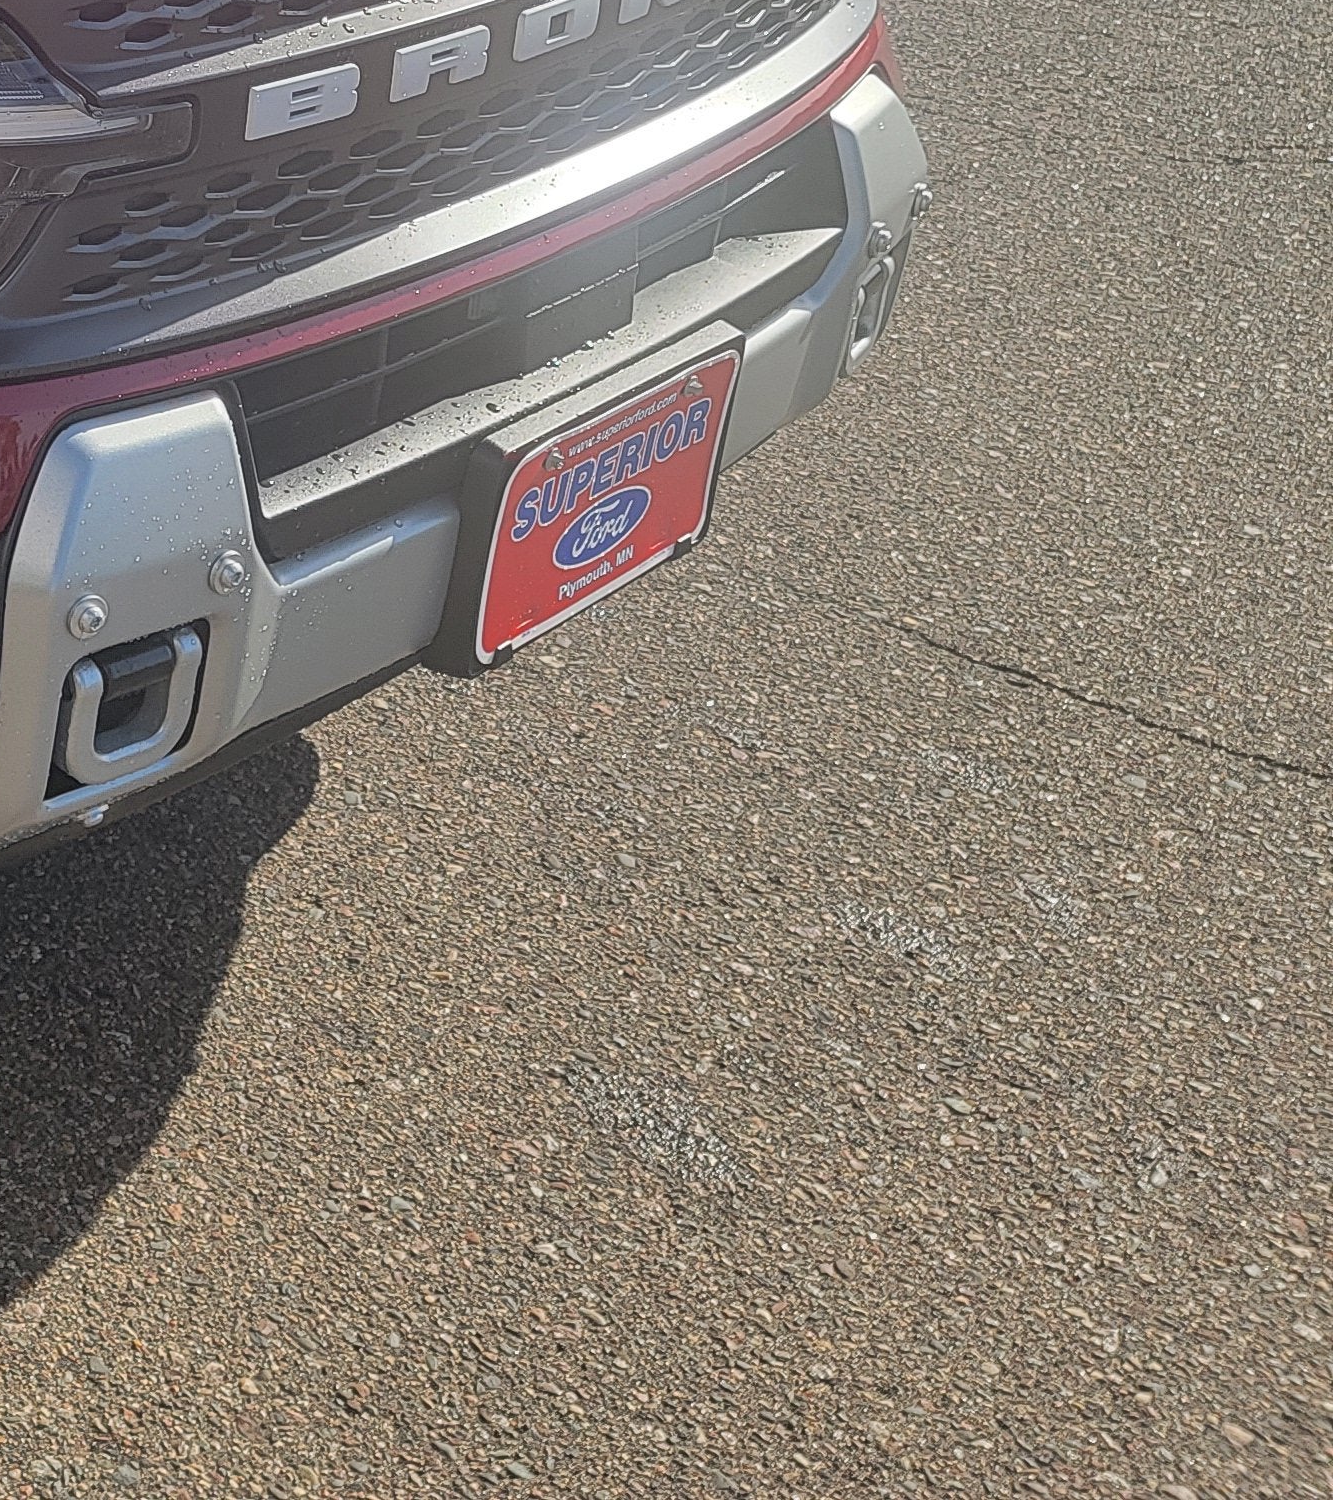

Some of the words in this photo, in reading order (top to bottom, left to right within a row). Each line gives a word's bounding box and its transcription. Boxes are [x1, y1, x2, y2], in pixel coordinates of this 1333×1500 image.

[568, 392, 677, 458] www.superiorford.com
[511, 397, 712, 542] SUPERIOR
[571, 498, 633, 558] Ford
[558, 560, 614, 601] Plymouth,
[615, 544, 634, 567] MN
